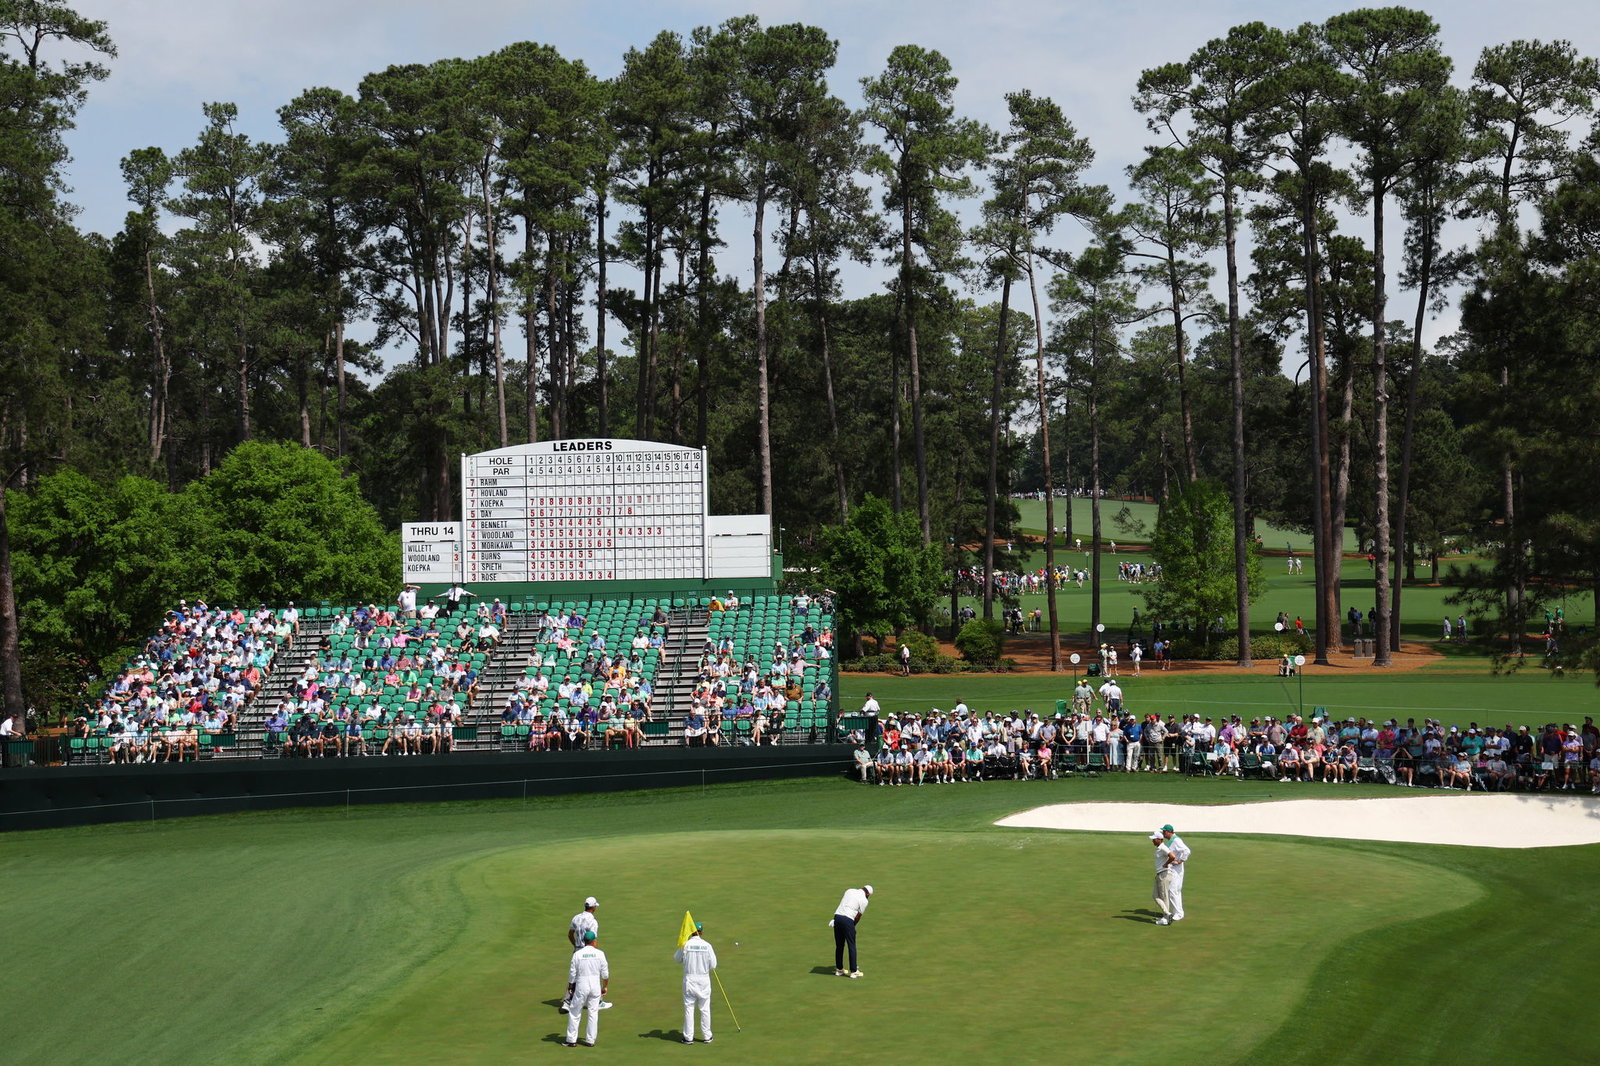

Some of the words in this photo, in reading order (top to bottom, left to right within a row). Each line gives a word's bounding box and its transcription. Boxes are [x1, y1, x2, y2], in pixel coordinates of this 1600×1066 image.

[553, 441, 612, 451] LEADERS
[548, 456, 553, 464] 3
[577, 455, 581, 463] 6
[615, 454, 622, 462] 10
[645, 453, 651, 461] 13
[558, 466, 563, 474] 3
[596, 465, 601, 473] 5
[636, 464, 641, 472] 3
[665, 463, 670, 471] 5
[540, 498, 544, 506] 8
[578, 497, 582, 505] 8
[587, 497, 592, 505] 8
[531, 509, 535, 517] 5
[559, 508, 563, 516] 7
[568, 508, 572, 516] 7
[597, 507, 601, 515] 6
[606, 507, 611, 515] 7
[618, 507, 622, 515] 7
[530, 519, 535, 527] 5
[549, 519, 554, 527] 5
[578, 518, 582, 526] 4
[597, 518, 601, 526] 5
[411, 527, 438, 535] THRU
[443, 527, 454, 535] 14
[559, 529, 563, 537] 5
[647, 527, 652, 535] 3
[657, 527, 661, 535] 3
[481, 541, 513, 549] MORIKAWA
[550, 540, 554, 548] 4
[559, 540, 564, 548] 5
[569, 540, 573, 548] 5
[588, 540, 592, 548] 5
[607, 539, 611, 547] 5
[408, 554, 440, 562] WOODLAND
[540, 551, 545, 559] 5
[578, 550, 583, 558] 5
[588, 550, 593, 558] 5
[531, 561, 536, 569] 3
[541, 561, 545, 569] 4
[560, 561, 564, 569] 5
[569, 561, 573, 569] 5
[481, 573, 497, 581] ROSE
[551, 572, 555, 580] 3
[570, 572, 574, 580] 3
[579, 571, 583, 579] 3
[588, 571, 593, 579] 3
[598, 571, 602, 579] 3
